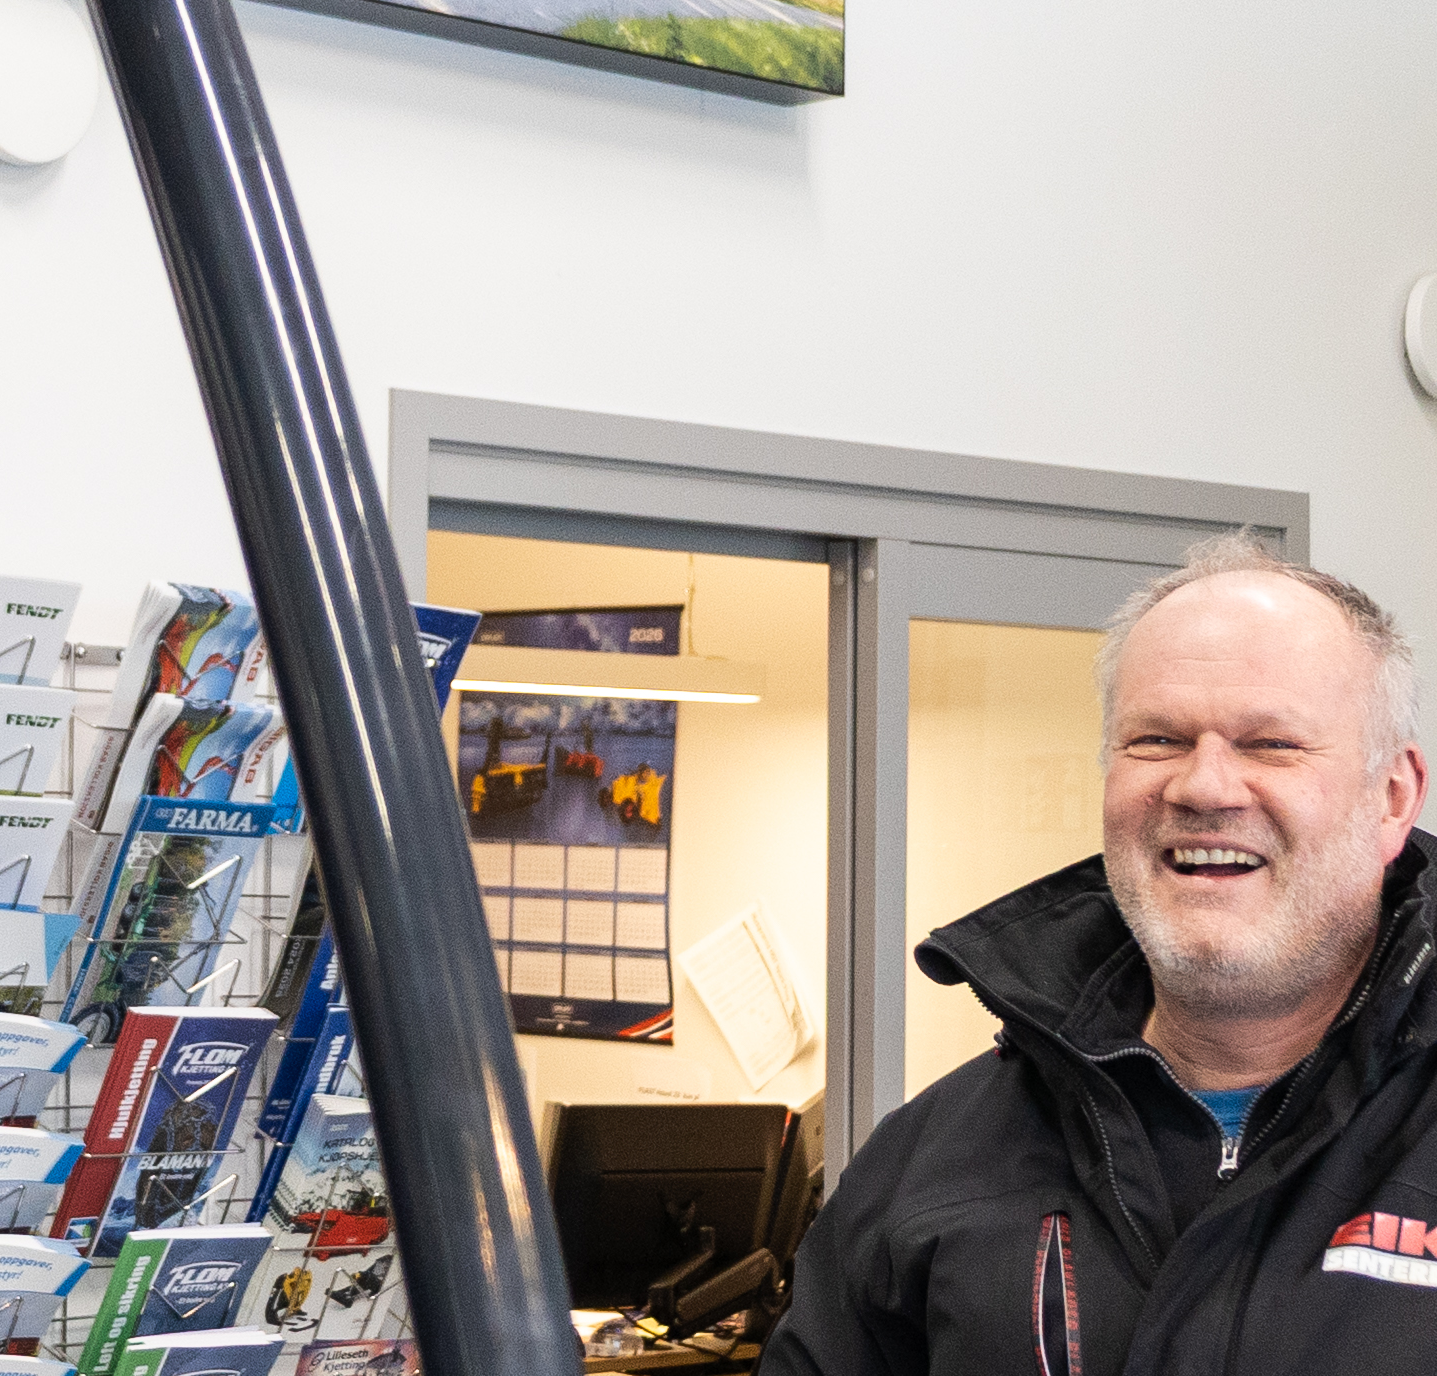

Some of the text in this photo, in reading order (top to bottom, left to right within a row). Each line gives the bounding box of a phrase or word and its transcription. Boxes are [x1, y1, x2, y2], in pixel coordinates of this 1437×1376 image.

[5, 602, 63, 620] FENDT
[5, 713, 62, 729] FENDT
[167, 808, 254, 833] FARMA
[171, 1040, 250, 1077] FLOM
[109, 1037, 159, 1140] Hjulkjetting
[0, 1255, 54, 1271] oppgaver,
[119, 1255, 152, 1314] sikring
[163, 1260, 242, 1296] FLOM
[326, 1349, 369, 1361] Lilleseth
[324, 1361, 366, 1374] Kjetting
